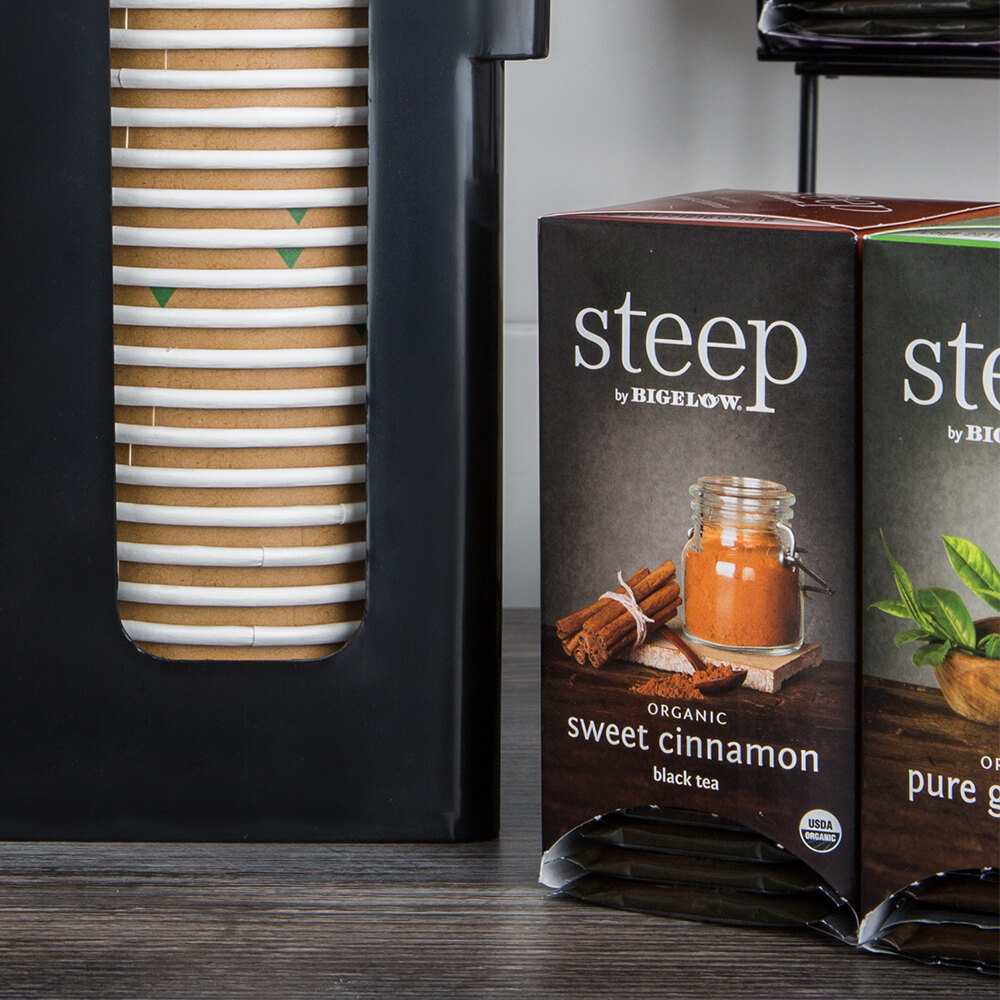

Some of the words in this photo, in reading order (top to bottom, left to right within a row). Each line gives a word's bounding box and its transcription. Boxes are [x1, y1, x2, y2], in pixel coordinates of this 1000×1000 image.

[574, 291, 808, 414] steep
[614, 388, 629, 405] by
[947, 424, 963, 443] by
[647, 702, 728, 725] ORGANIC
[567, 716, 650, 751] sweet
[658, 726, 820, 773] cinnamon
[653, 766, 692, 787] black
[696, 774, 720, 791] tea
[907, 768, 977, 804] pure
[808, 818, 833, 830] USDA
[804, 831, 837, 843] ORGANIC
